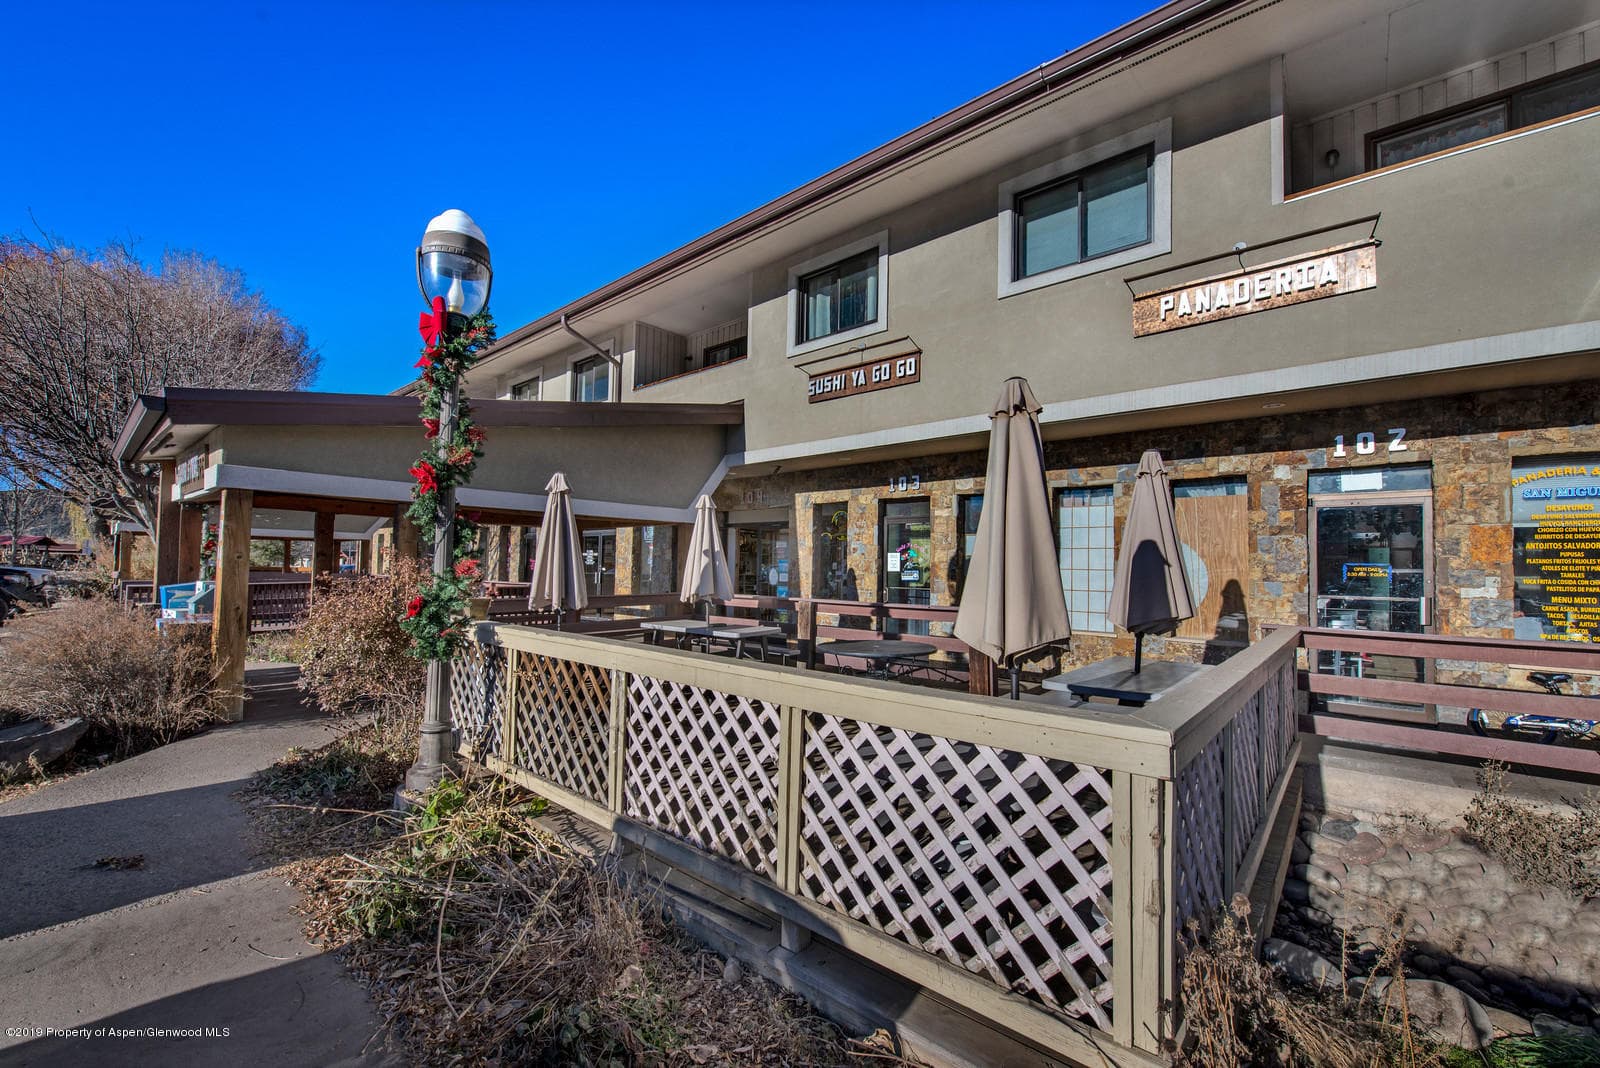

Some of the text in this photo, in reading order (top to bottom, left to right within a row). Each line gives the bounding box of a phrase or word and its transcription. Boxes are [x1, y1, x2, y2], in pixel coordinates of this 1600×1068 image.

[1160, 255, 1338, 320] PANADERIA
[808, 357, 915, 395] SUSHI YA GO GO
[888, 475, 920, 492] 103
[1511, 466, 1587, 487] PANADERIA
[1522, 486, 1600, 500] SAN MIGU
[1546, 504, 1594, 512] DESAYUNOS
[1526, 542, 1562, 550] ANTOJITOS
[1551, 596, 1598, 605] MENU MIXTO
